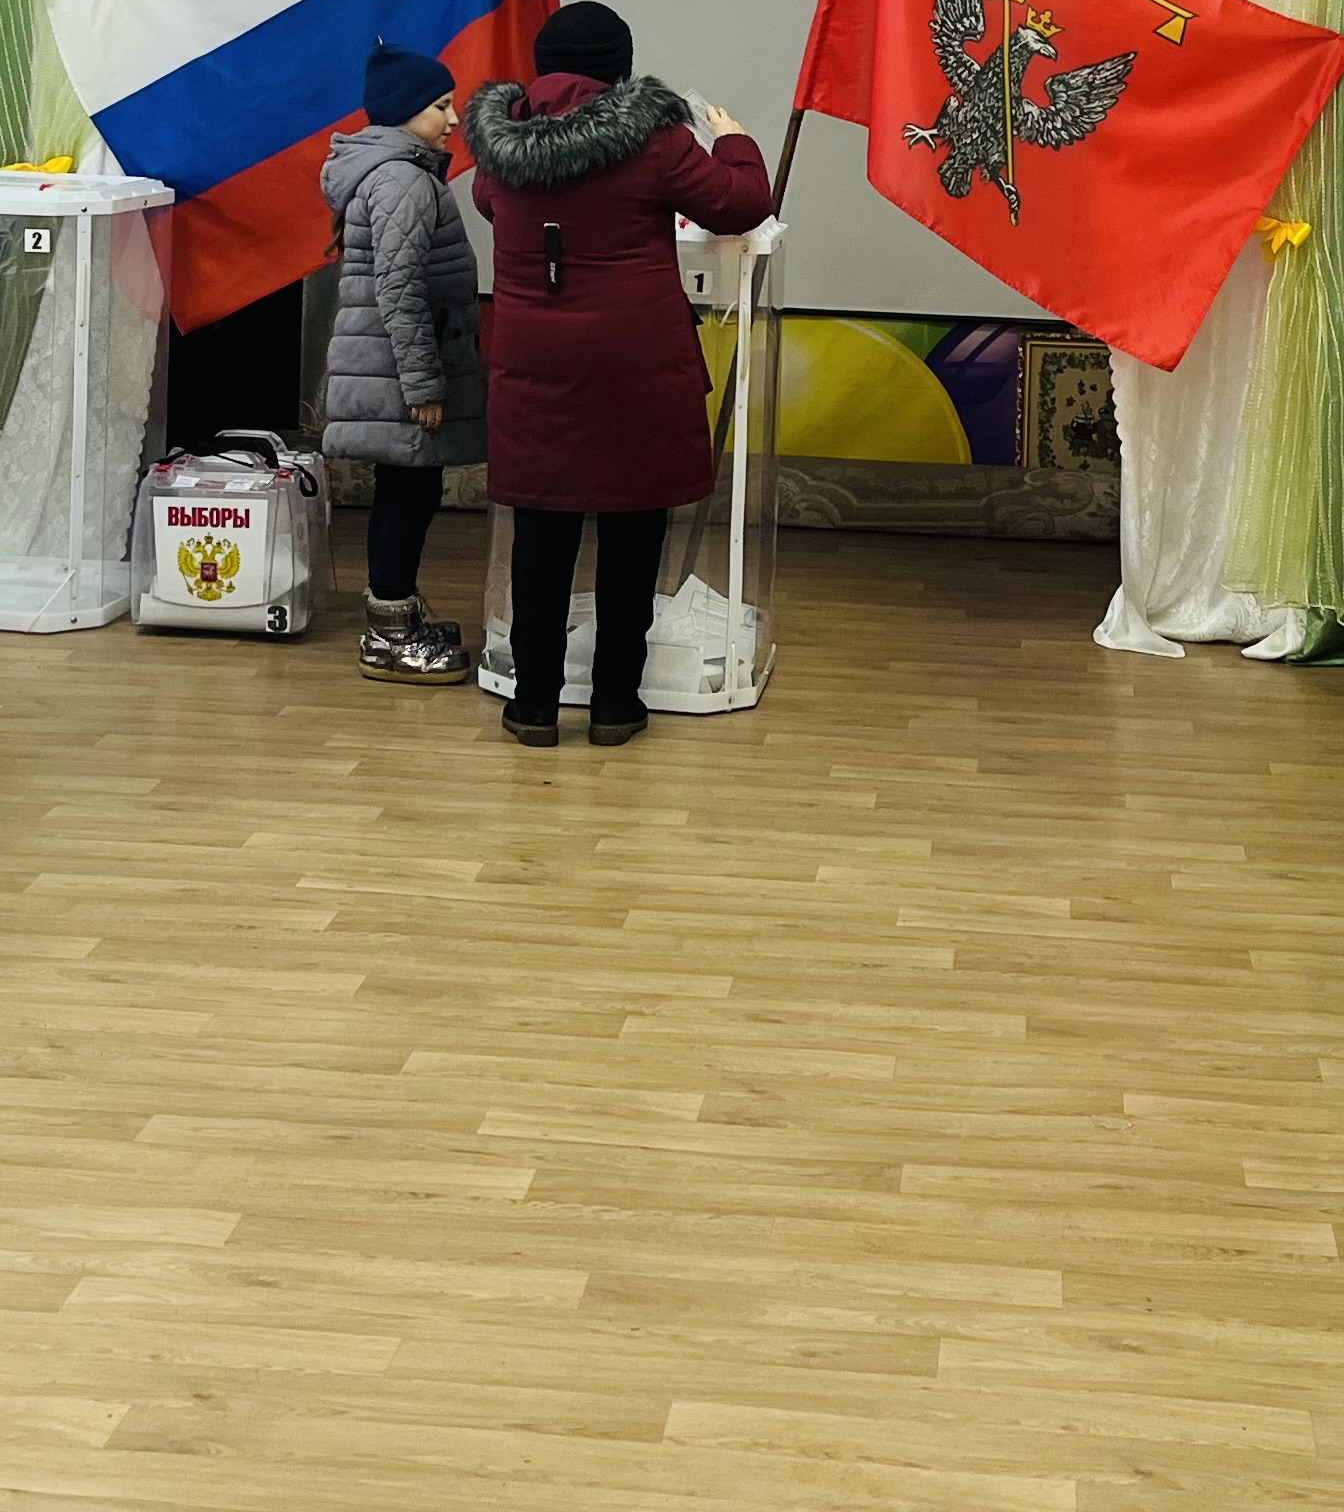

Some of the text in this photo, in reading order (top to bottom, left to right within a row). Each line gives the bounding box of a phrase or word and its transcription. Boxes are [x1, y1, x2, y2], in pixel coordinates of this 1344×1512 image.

[31, 231, 43, 250] 2
[693, 272, 705, 293] 1
[167, 506, 251, 529] ВЫБОРЫ
[267, 605, 288, 632] 3
